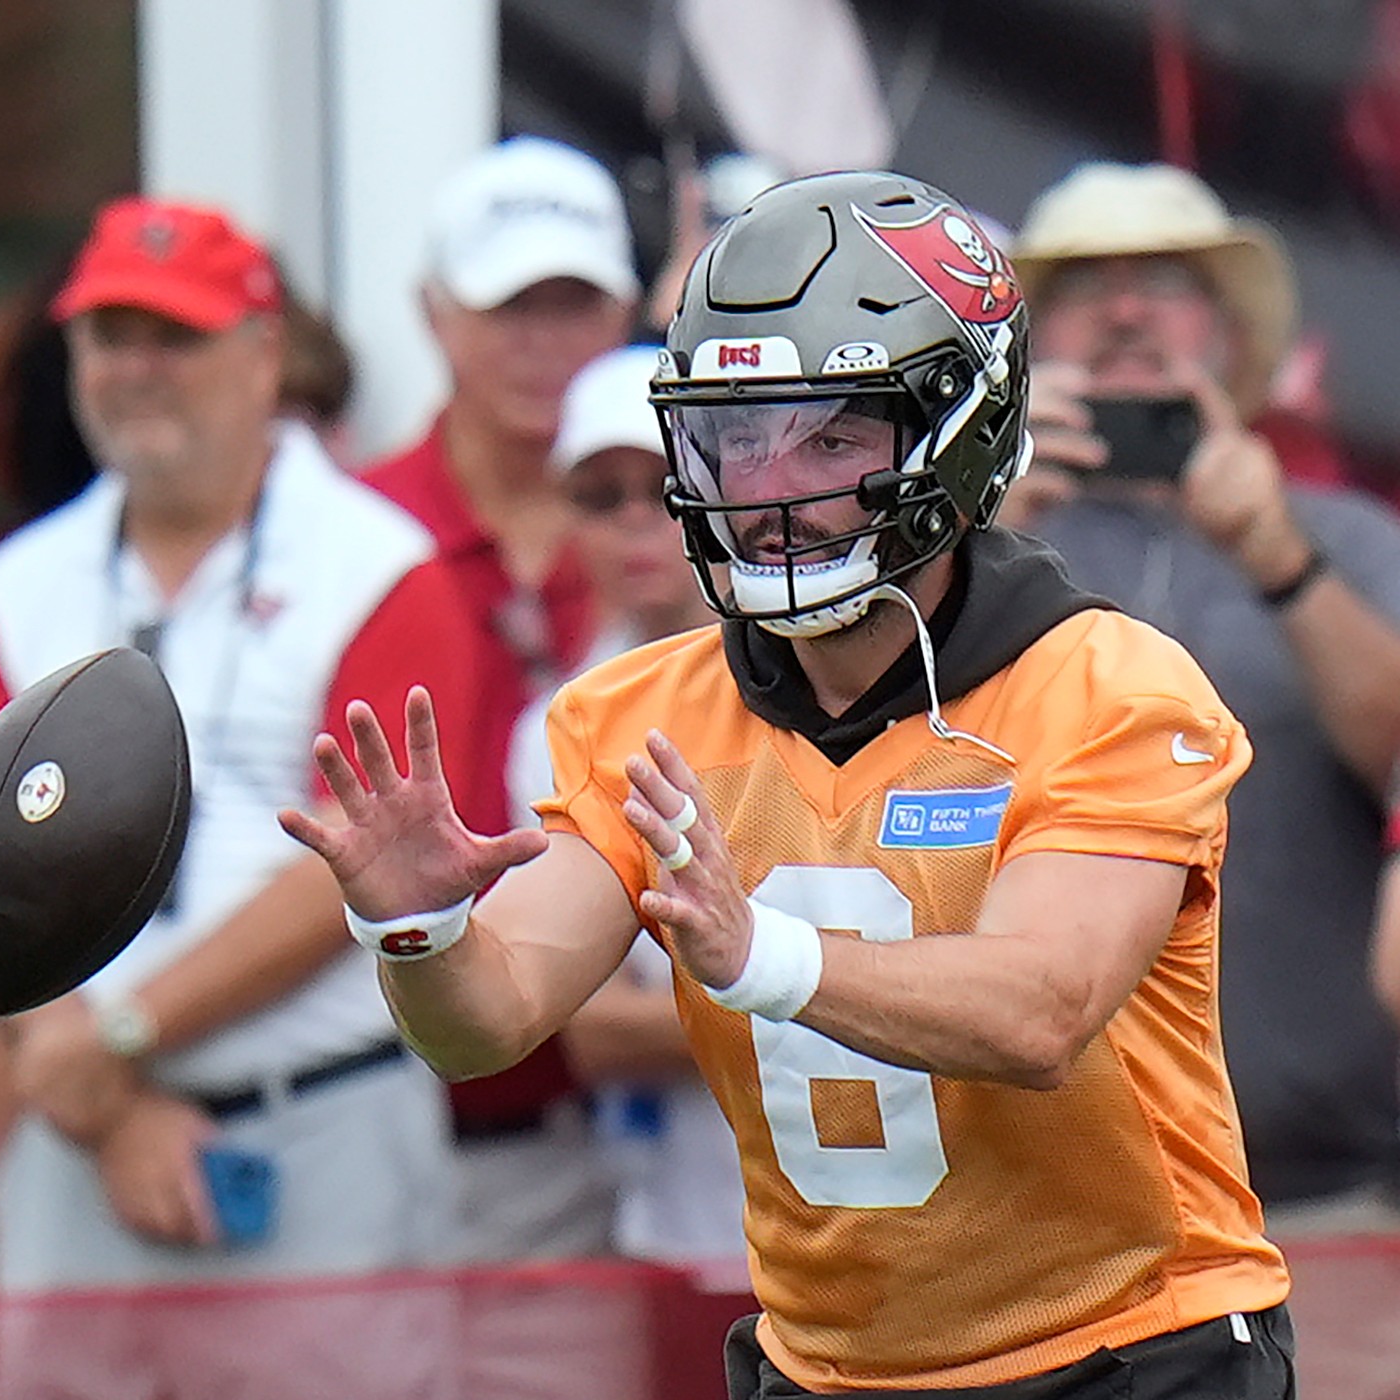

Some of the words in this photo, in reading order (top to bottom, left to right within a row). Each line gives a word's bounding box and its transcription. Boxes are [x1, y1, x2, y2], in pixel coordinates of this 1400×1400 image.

[827, 359, 884, 370] OAKLEY
[931, 807, 971, 819] FIFTH
[929, 820, 968, 832] BANK
[746, 865, 950, 1209] 6
